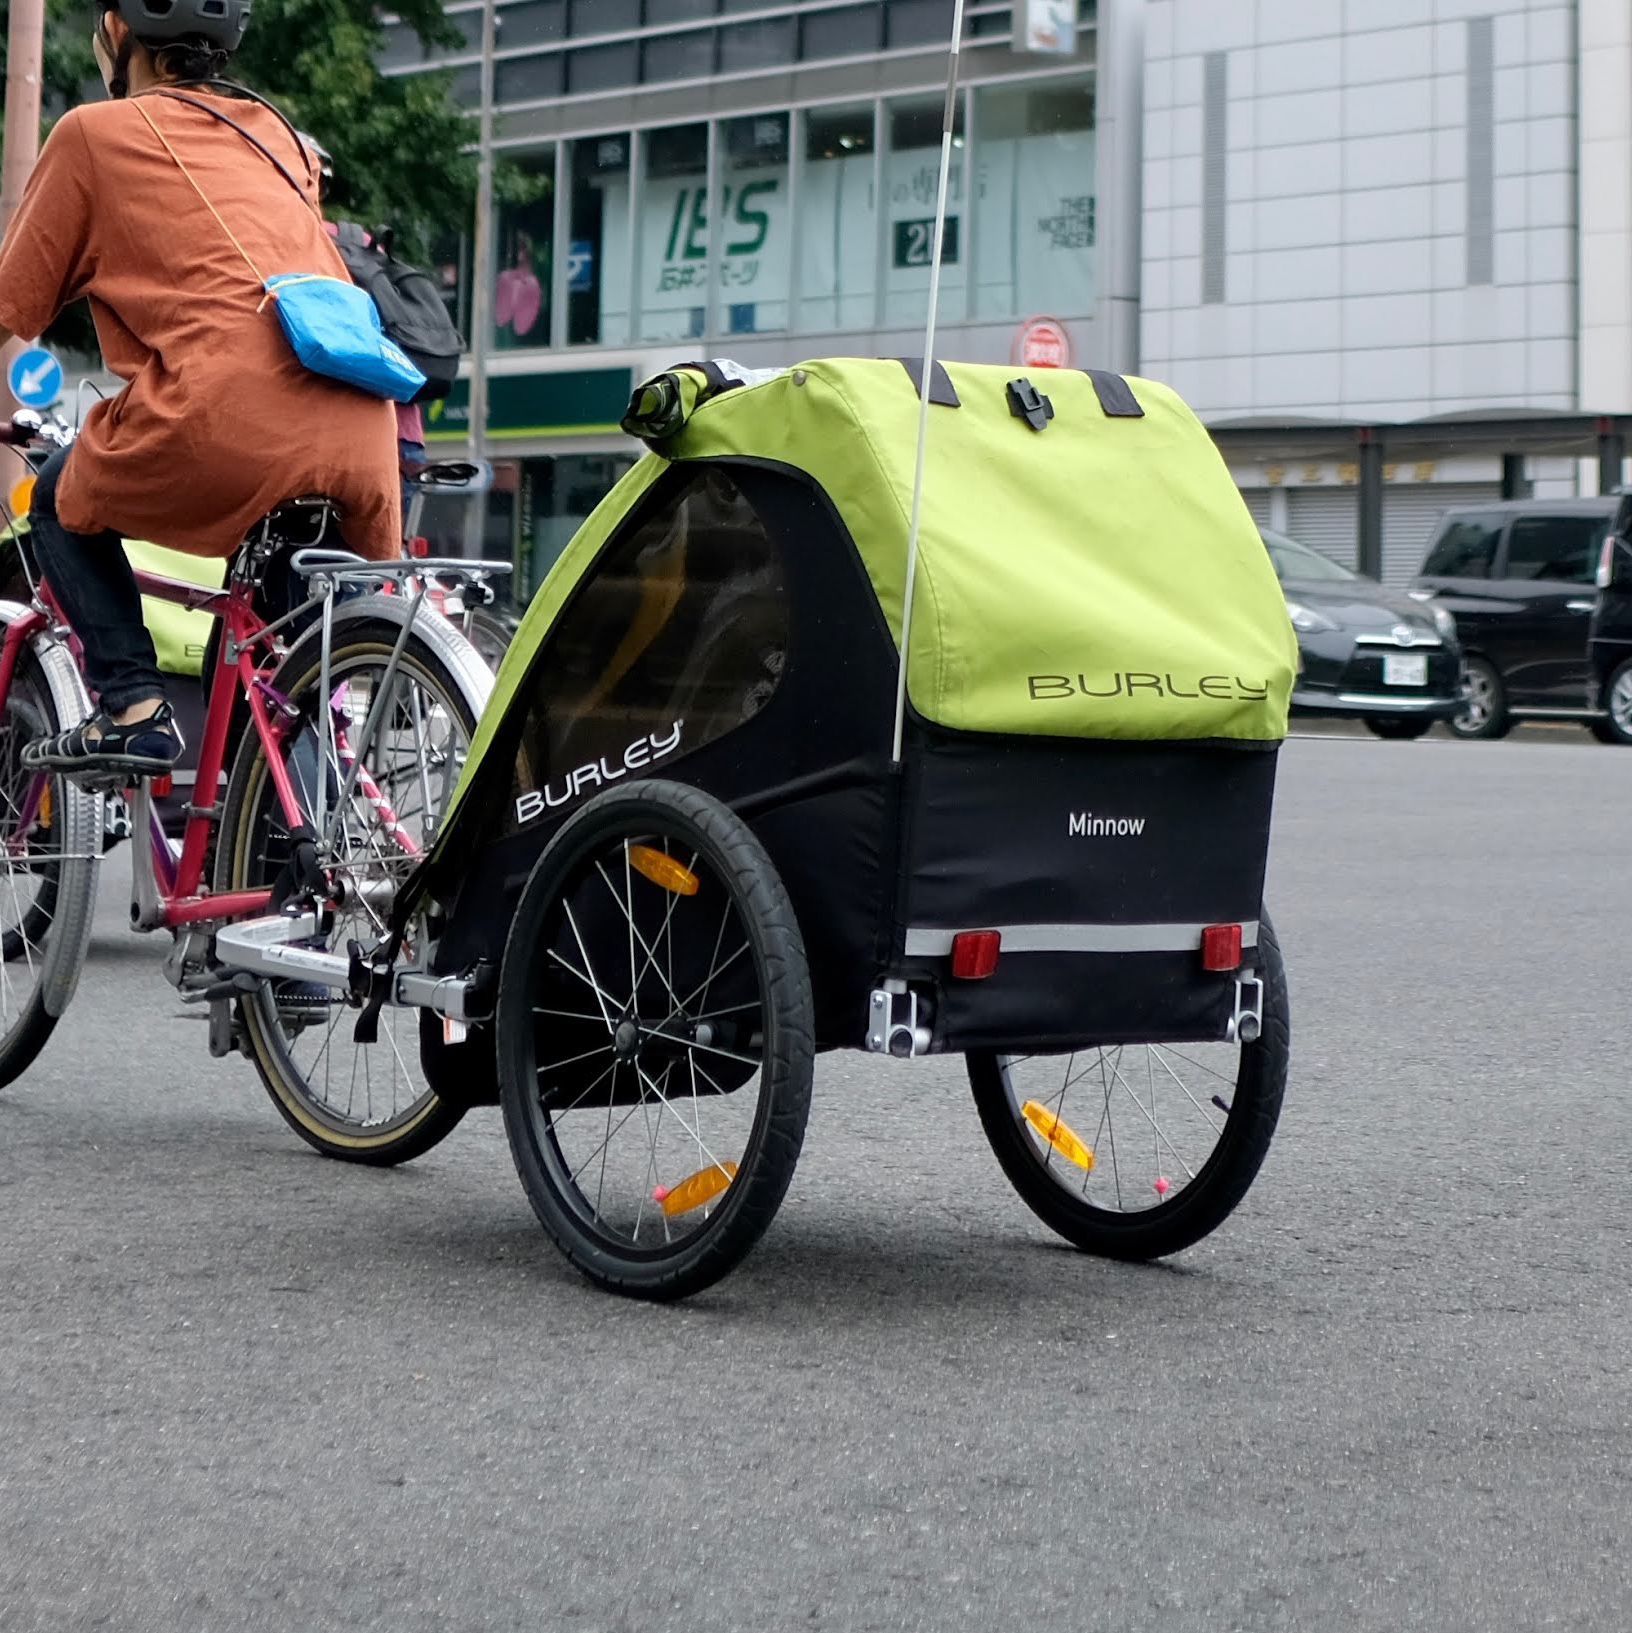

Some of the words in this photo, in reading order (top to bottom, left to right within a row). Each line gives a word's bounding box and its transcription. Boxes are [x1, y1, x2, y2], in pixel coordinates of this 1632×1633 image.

[1028, 672, 1270, 701] BURLEY
[515, 718, 684, 825] BURLEY
[1068, 813, 1145, 837] Minnow
